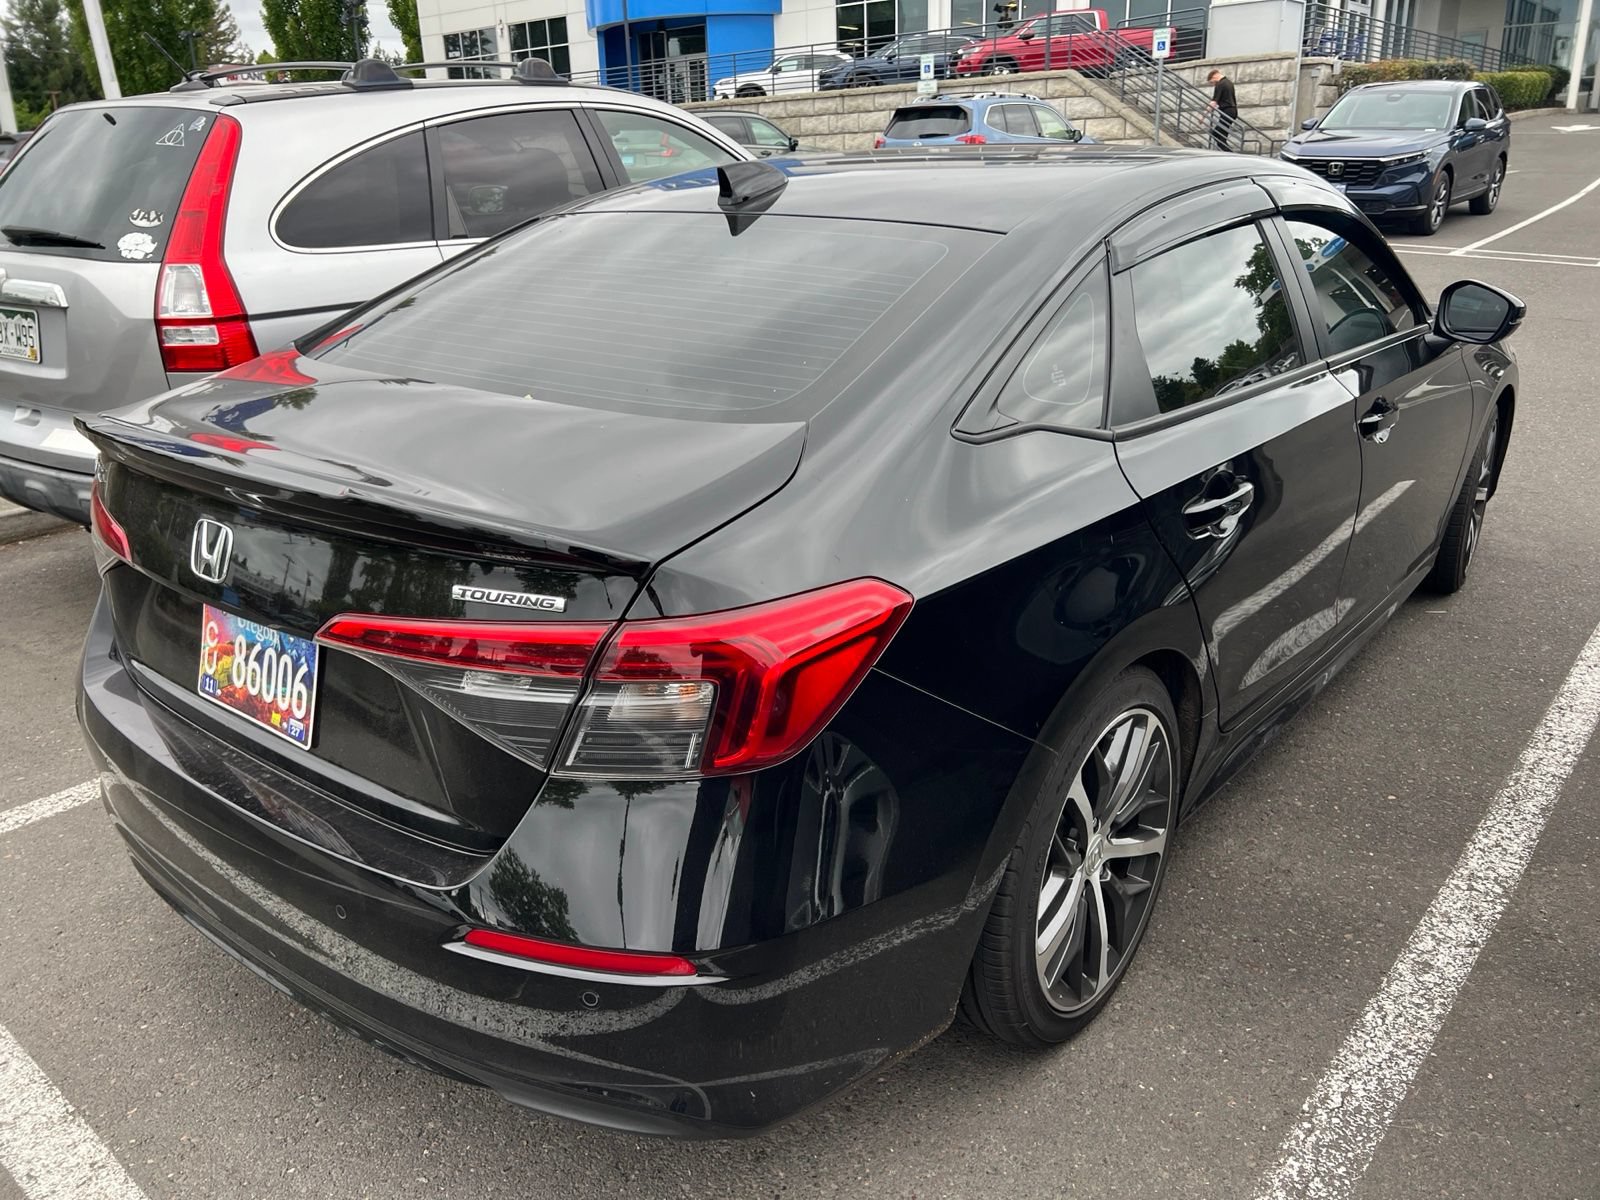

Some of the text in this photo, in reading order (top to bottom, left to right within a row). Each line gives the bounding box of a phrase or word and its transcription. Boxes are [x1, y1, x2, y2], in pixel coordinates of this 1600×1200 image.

[131, 210, 163, 222] JAX
[458, 588, 556, 608] TOURING
[237, 617, 277, 642] Oregon
[204, 676, 214, 693] 11
[232, 634, 309, 719] 86006
[290, 726, 300, 738] 27
